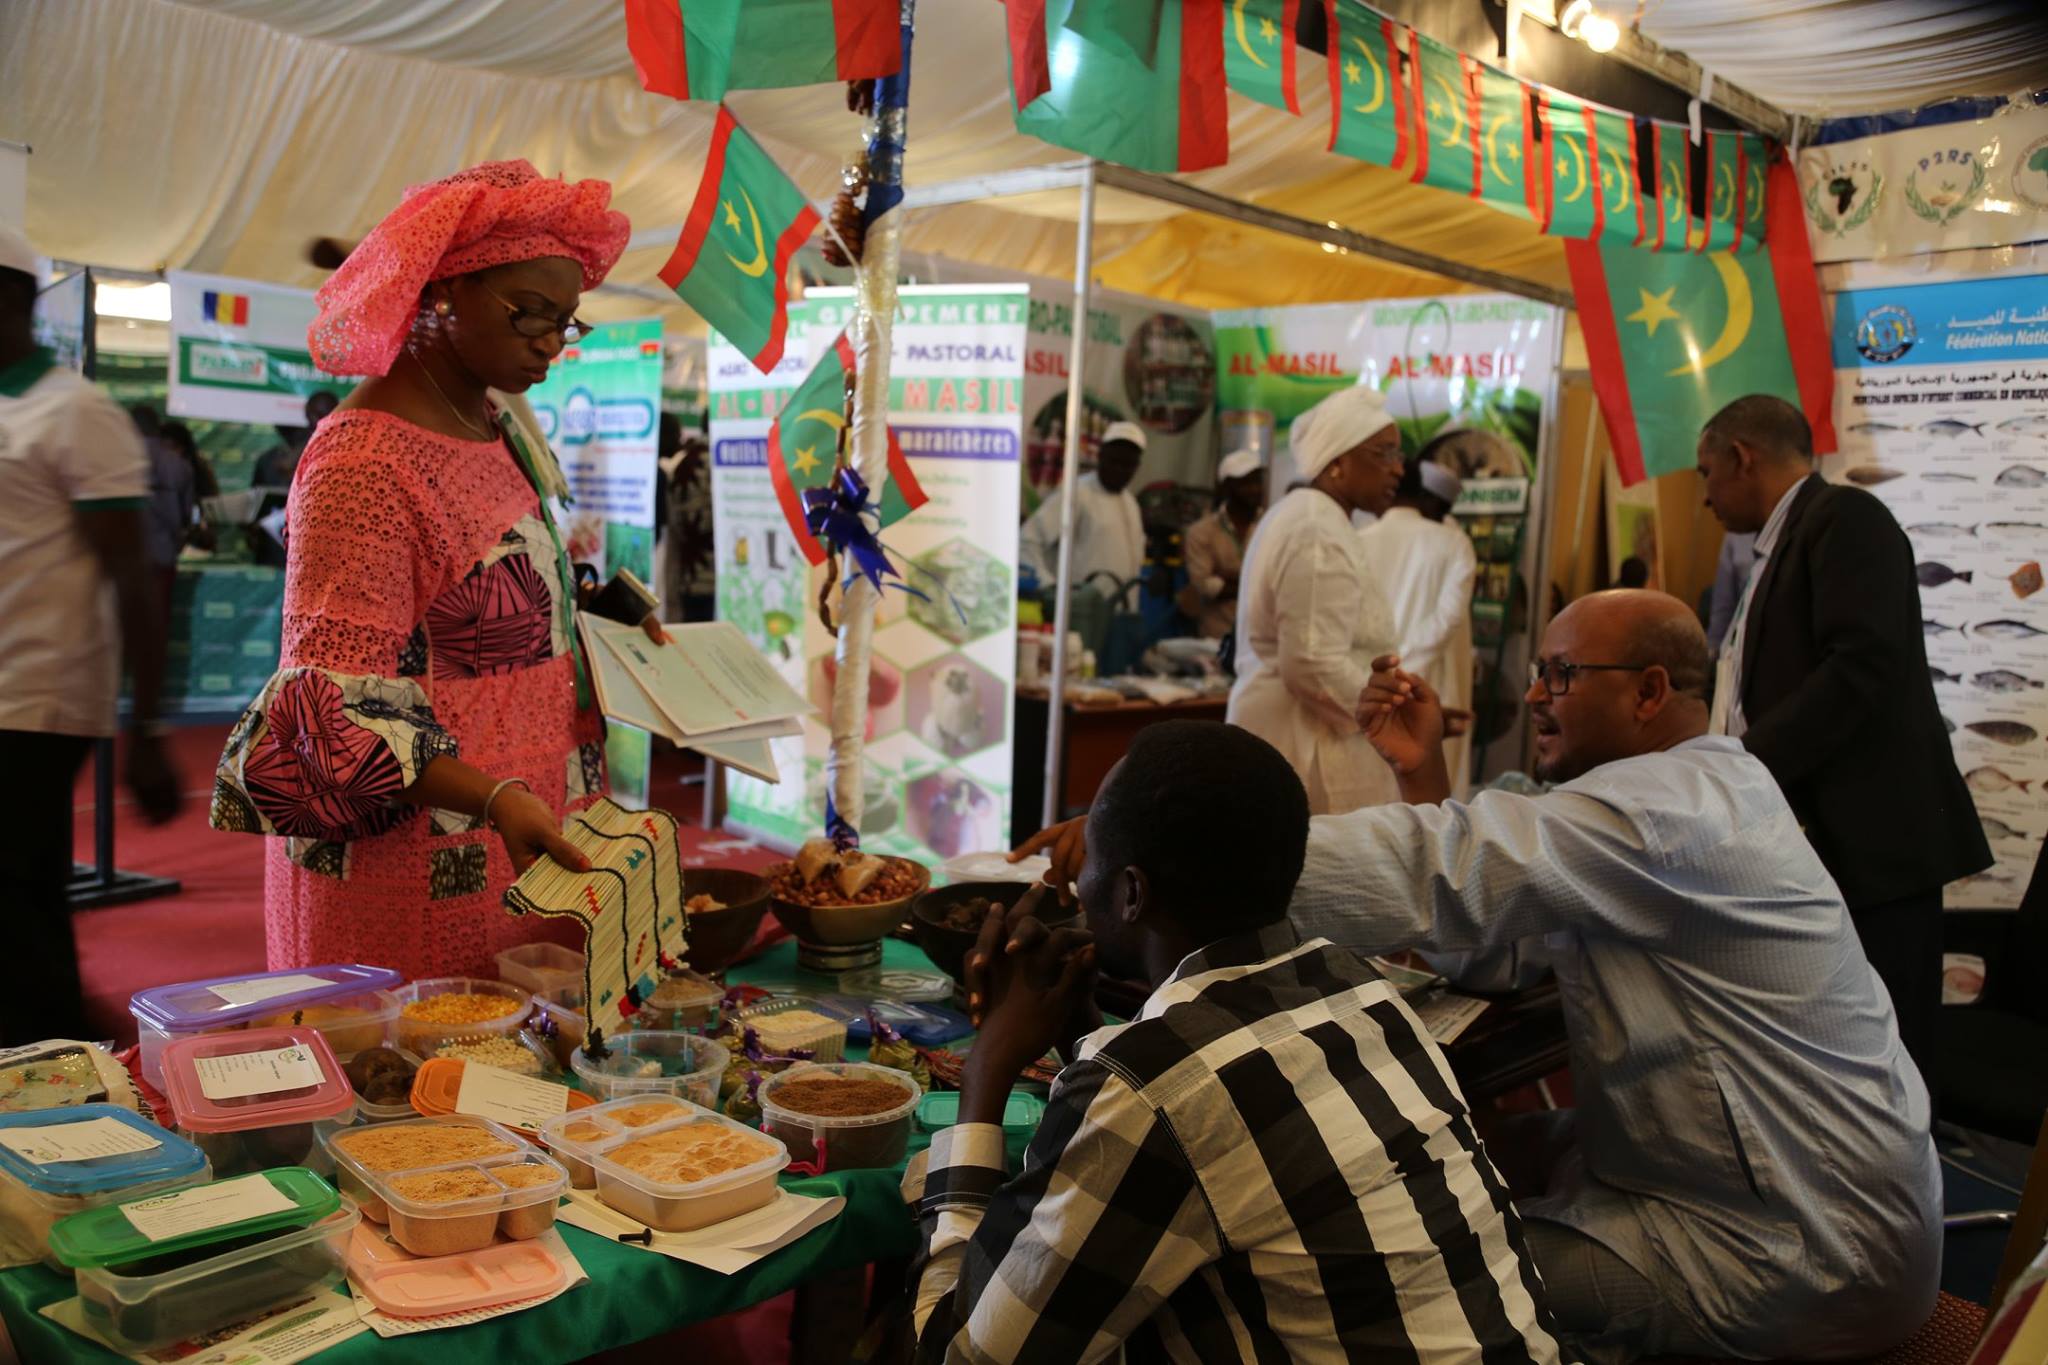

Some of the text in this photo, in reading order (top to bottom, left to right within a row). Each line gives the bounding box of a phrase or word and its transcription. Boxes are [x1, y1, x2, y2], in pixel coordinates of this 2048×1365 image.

[1919, 149, 1972, 173] P2RS
[906, 344, 1016, 363] PASTORAL
[1228, 352, 1342, 377] AL-MASIL
[1388, 353, 1525, 379] AL-MASIL
[904, 380, 1019, 413] MASIL
